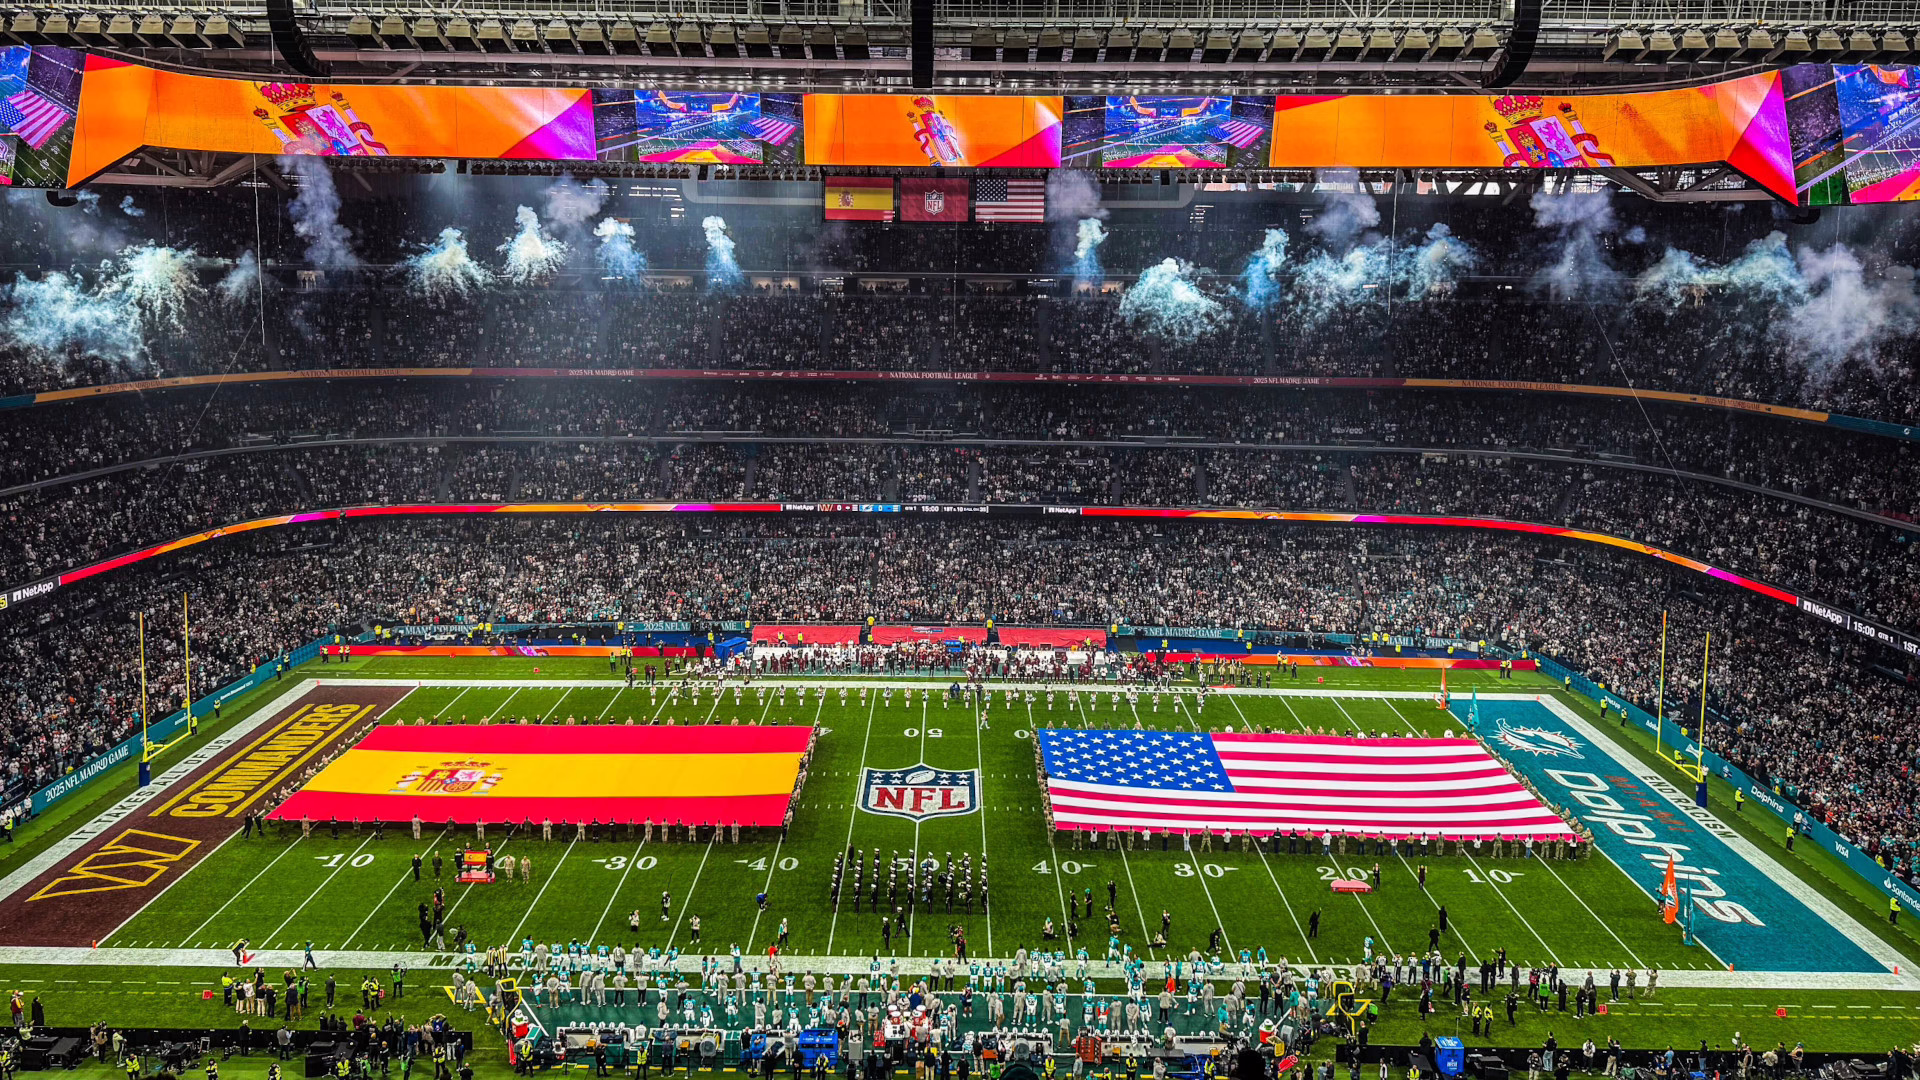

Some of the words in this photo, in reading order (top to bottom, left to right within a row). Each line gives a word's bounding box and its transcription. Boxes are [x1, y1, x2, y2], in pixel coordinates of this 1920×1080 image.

[926, 201, 942, 210] NFL
[337, 370, 372, 378] FOOTBALL
[568, 369, 584, 377] 2025
[1499, 381, 1534, 389] FOOTBALL
[1536, 382, 1563, 391] LEAGUE
[792, 504, 814, 512] NetApp
[1055, 507, 1077, 515] NetApp
[22, 580, 54, 600] NetApp
[1812, 603, 1843, 625] NetApp
[643, 621, 664, 631] 2025
[664, 621, 680, 631] NFL
[1149, 627, 1165, 637] NFL
[1198, 629, 1220, 638] GAME
[1853, 620, 1876, 638] 15:00
[1903, 640, 1918, 654] 1ST
[169, 703, 362, 818] COMMANDERS
[45, 783, 65, 803] 2025
[65, 774, 80, 792] NFL
[80, 759, 109, 782] MADRID
[109, 745, 129, 763] GAME
[69, 830, 91, 840] IT
[94, 791, 155, 824] TAKES
[155, 767, 188, 786] ALL
[187, 752, 208, 765] OF
[207, 739, 232, 750] US
[873, 787, 966, 813] NFL
[1750, 785, 1785, 814] Dolphins
[1641, 775, 1677, 794] END
[1670, 796, 1739, 840] RACISM
[1544, 768, 1766, 927] Dolphins
[1834, 840, 1850, 859] VISA
[321, 853, 375, 868] 10
[604, 856, 658, 870] 30
[747, 856, 799, 871] 40
[1032, 860, 1082, 874] 40
[1174, 863, 1225, 878] 30
[1316, 866, 1369, 882] 20
[1463, 868, 1513, 884] 10
